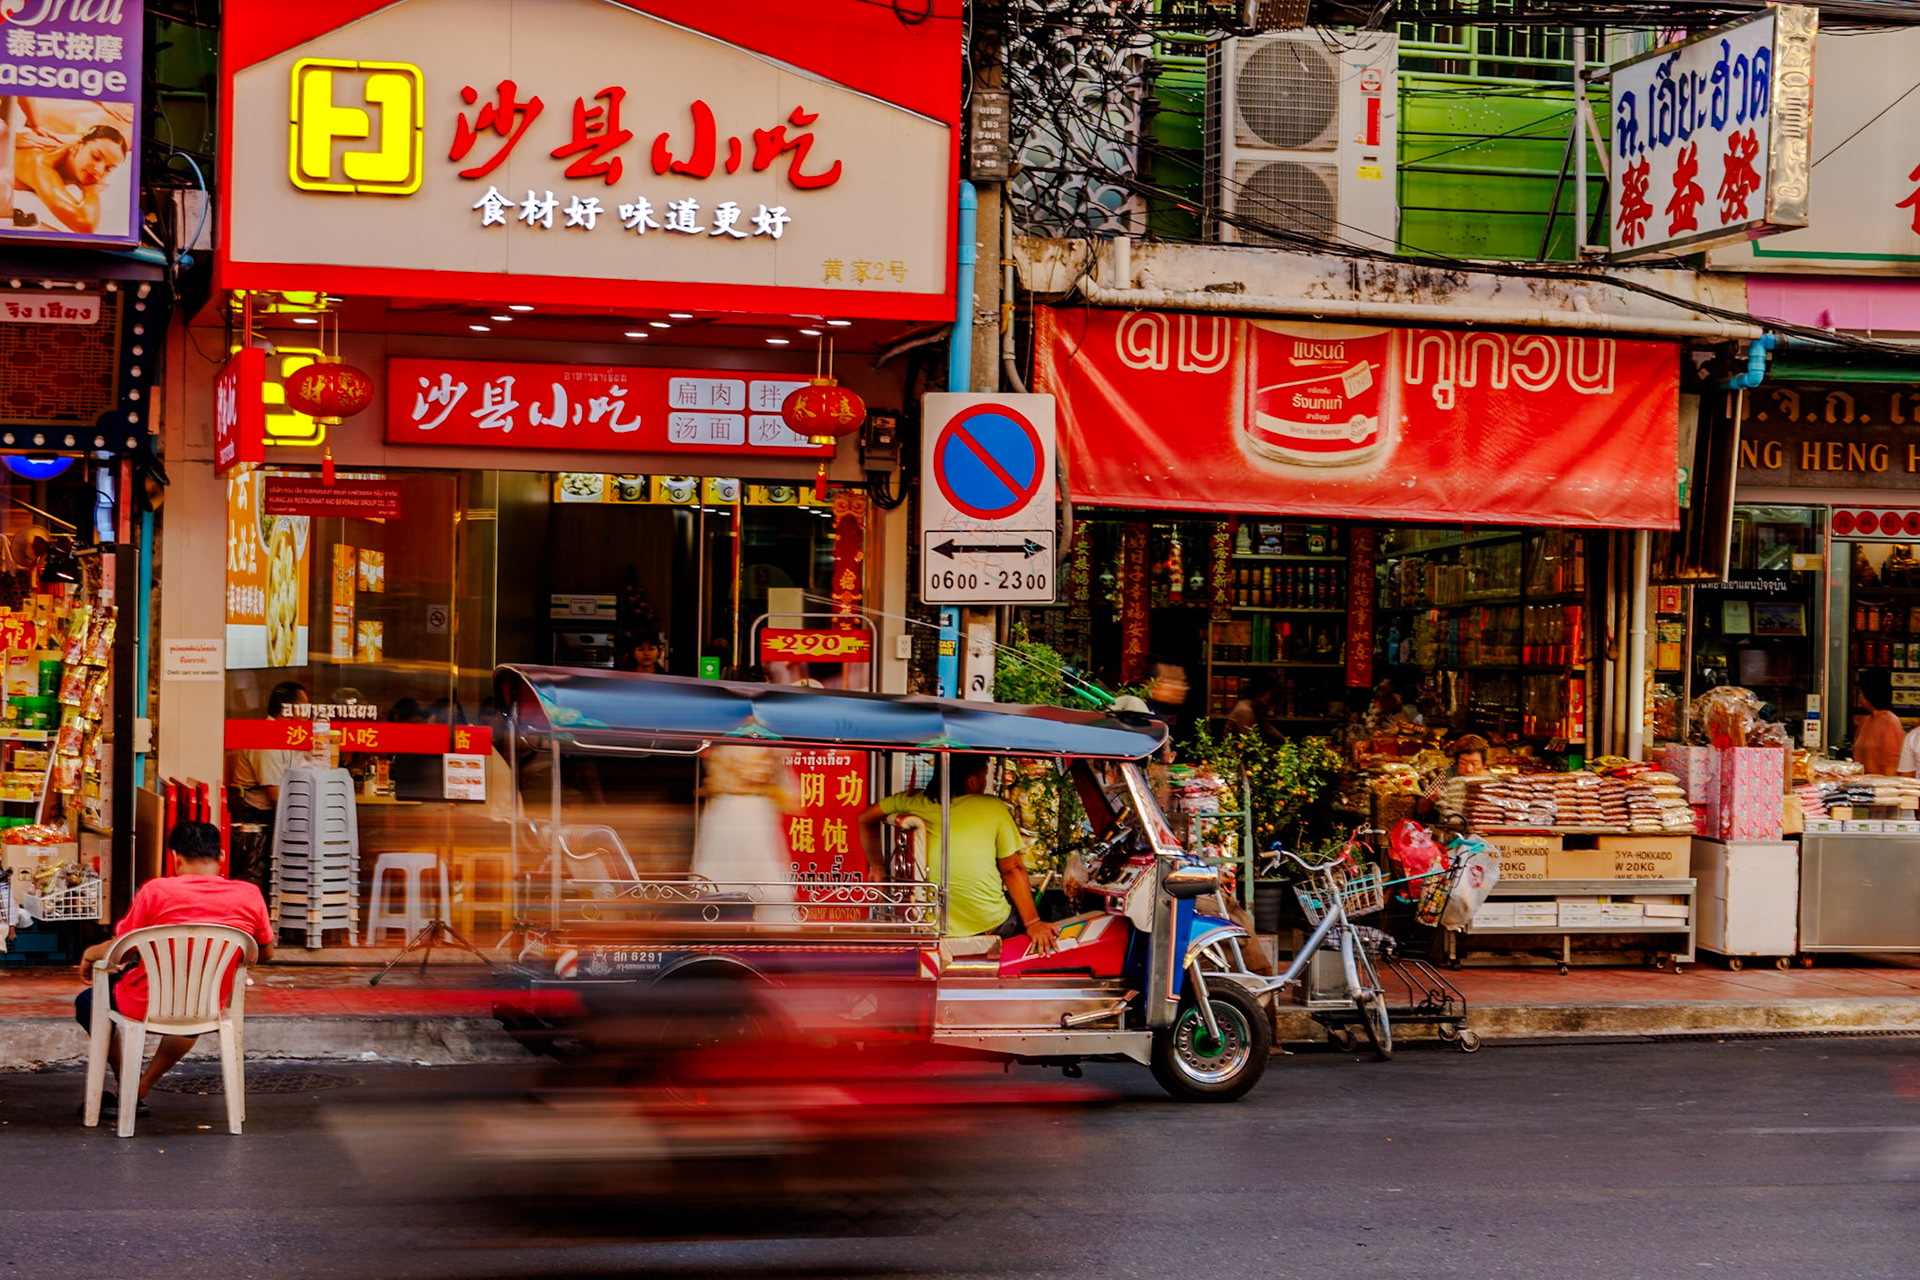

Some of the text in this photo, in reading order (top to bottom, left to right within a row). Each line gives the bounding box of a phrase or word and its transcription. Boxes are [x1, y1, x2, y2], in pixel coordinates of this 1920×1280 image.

[6, 28, 123, 63] 泰式按摩
[448, 79, 843, 189] 沙县小吃
[1616, 127, 1762, 247] 蔡益發
[473, 185, 793, 240] 食材好 味道更好
[820, 257, 909, 285] 黄家2号
[1294, 341, 1345, 360] แบรนด์
[411, 373, 642, 434] 沙县小吃
[676, 382, 732, 407] 扁肉
[1292, 393, 1344, 411] รังนกแท้
[675, 416, 732, 441] 汤面
[1801, 441, 1890, 473] HENG
[931, 571, 978, 590] 0600
[998, 571, 1046, 590] 2300
[782, 635, 841, 652] 290
[287, 725, 379, 748] 沙小吃
[800, 770, 864, 808] 阴功
[788, 816, 850, 854] 馄饨
[1626, 862, 1656, 872] 20KG
[631, 951, 663, 963] 6291
